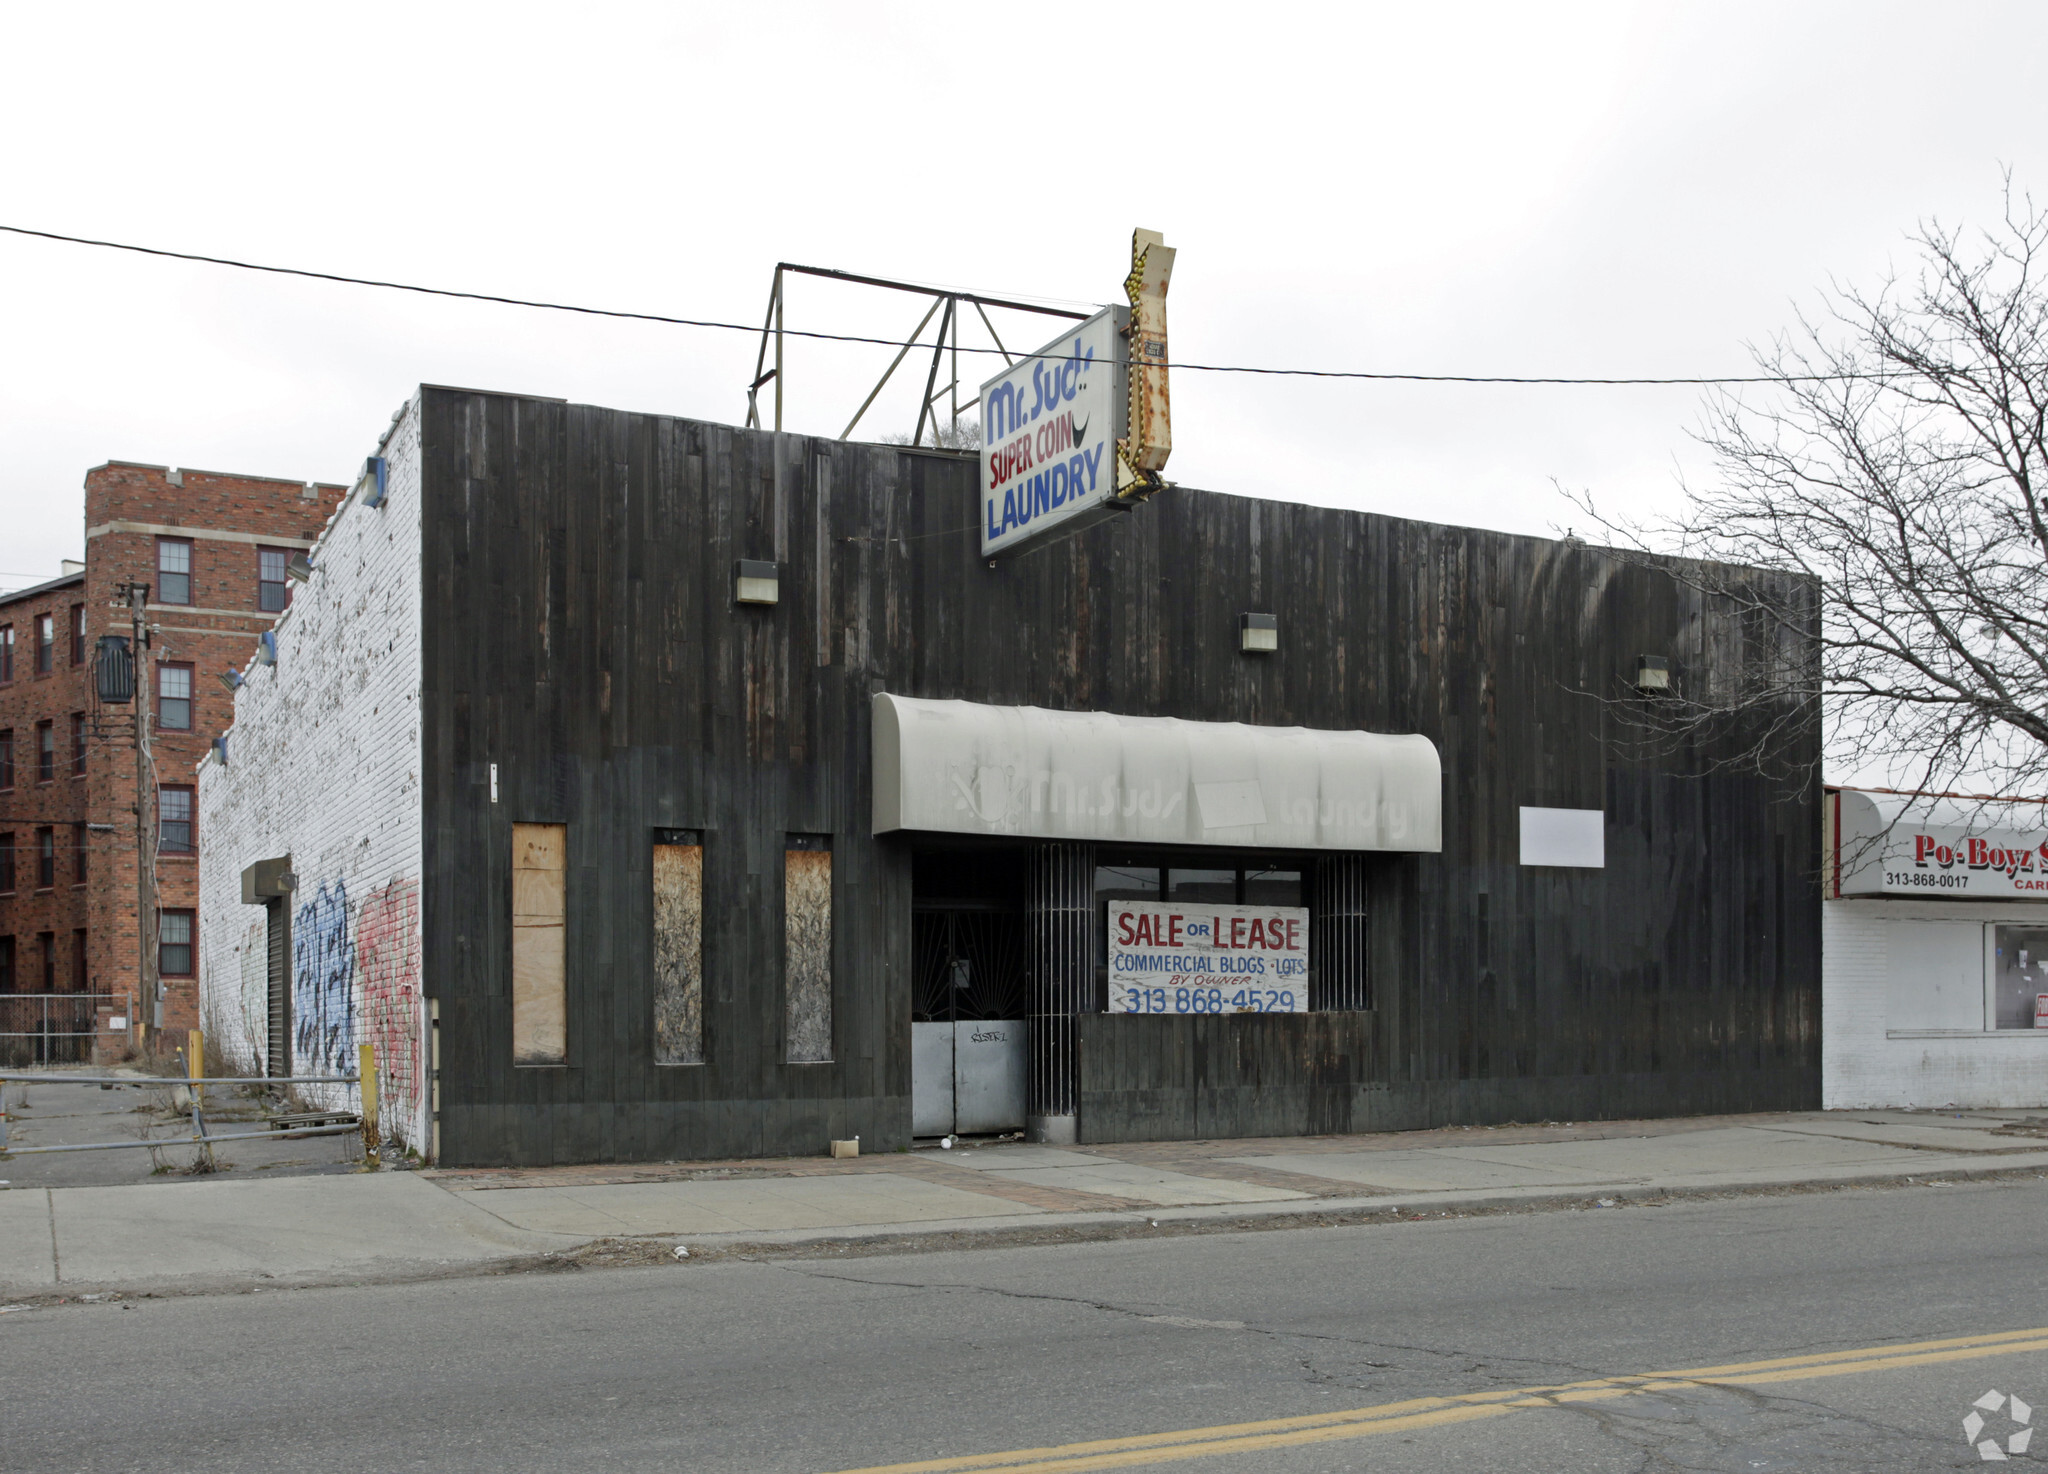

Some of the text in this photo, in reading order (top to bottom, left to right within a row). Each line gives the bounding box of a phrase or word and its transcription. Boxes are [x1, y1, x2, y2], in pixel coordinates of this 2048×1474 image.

[990, 410, 1072, 490] SUPER COIN
[987, 441, 1105, 541] LAUNDRY
[1914, 834, 2034, 880] Po-Boyz
[1886, 872, 1969, 888] 313-868-0017
[2014, 879, 2048, 891] CAR
[1118, 912, 1301, 951] SALE OR LEASE
[1115, 953, 1305, 975] COMMERCIAL BLDGS LOTS
[1169, 974, 1252, 986] BY OWNER
[1126, 988, 1295, 1014] 313 868-4529
